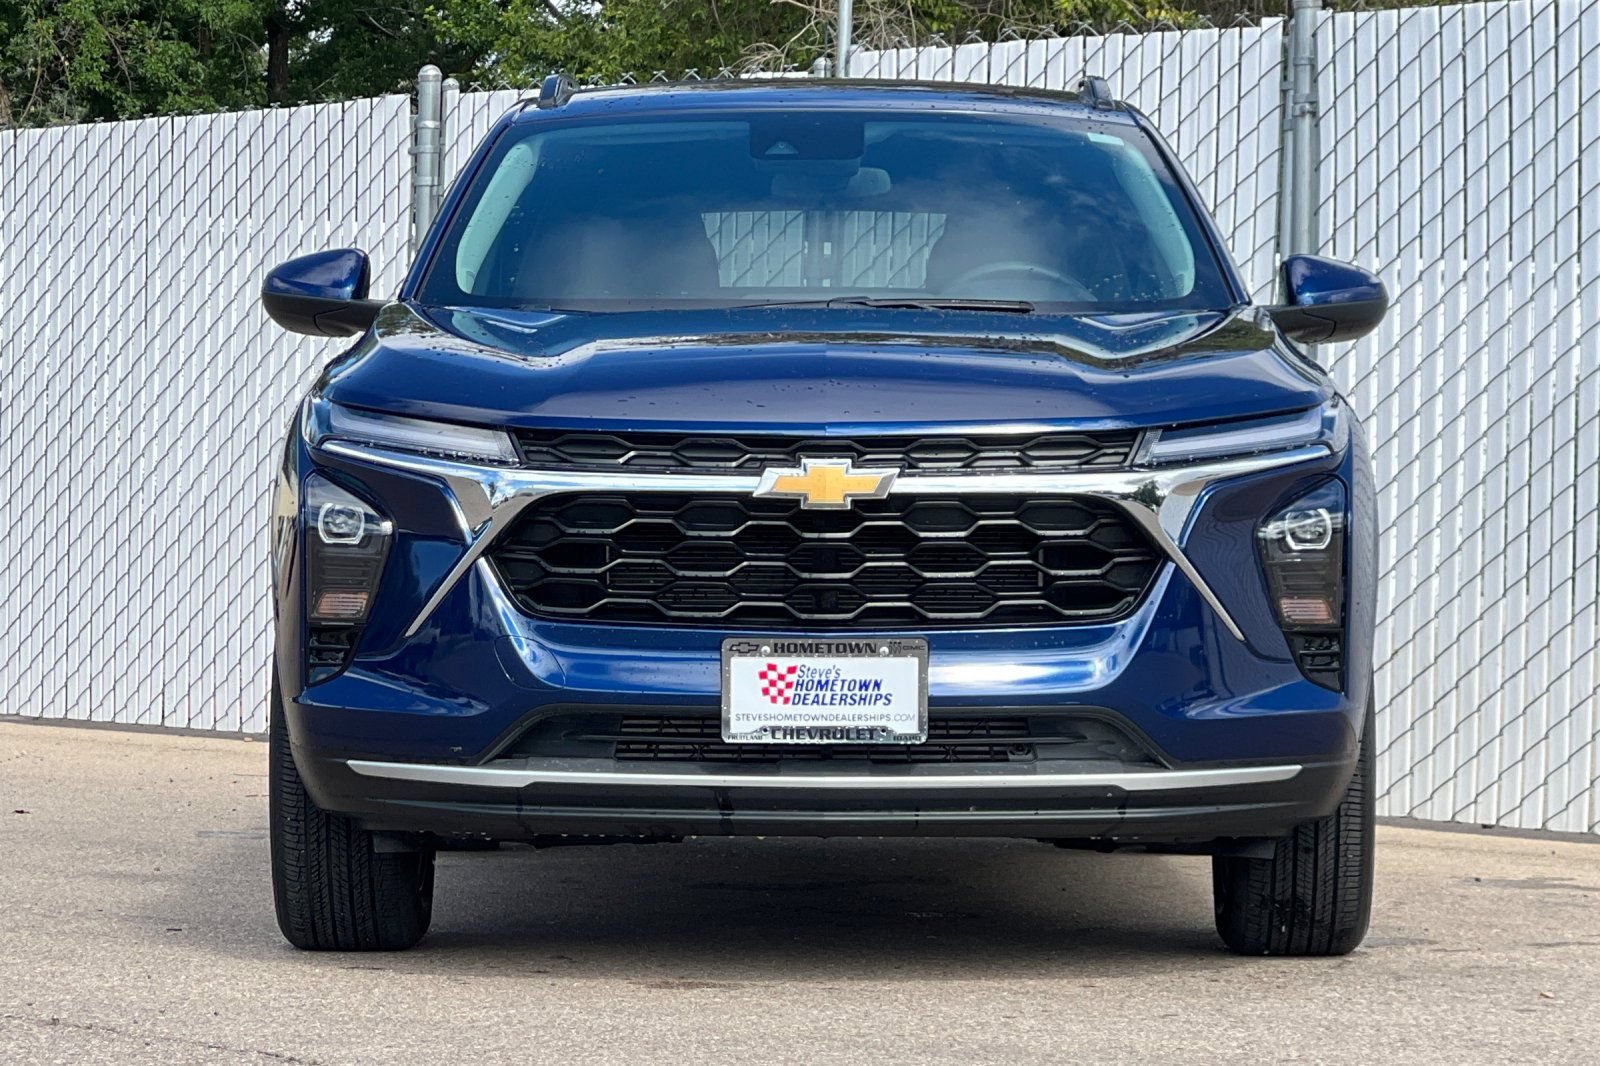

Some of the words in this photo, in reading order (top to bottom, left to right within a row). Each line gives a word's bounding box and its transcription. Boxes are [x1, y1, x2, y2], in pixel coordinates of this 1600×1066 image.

[774, 642, 877, 654] HOMETOWN
[797, 664, 841, 679] Steve's
[794, 679, 883, 691] HOMETOWN
[791, 692, 893, 706] DEALERSHIPS
[735, 713, 916, 722] STEVESHOMETOWNDEALERSHIPS.COM
[771, 727, 878, 741] CHEVROLET
